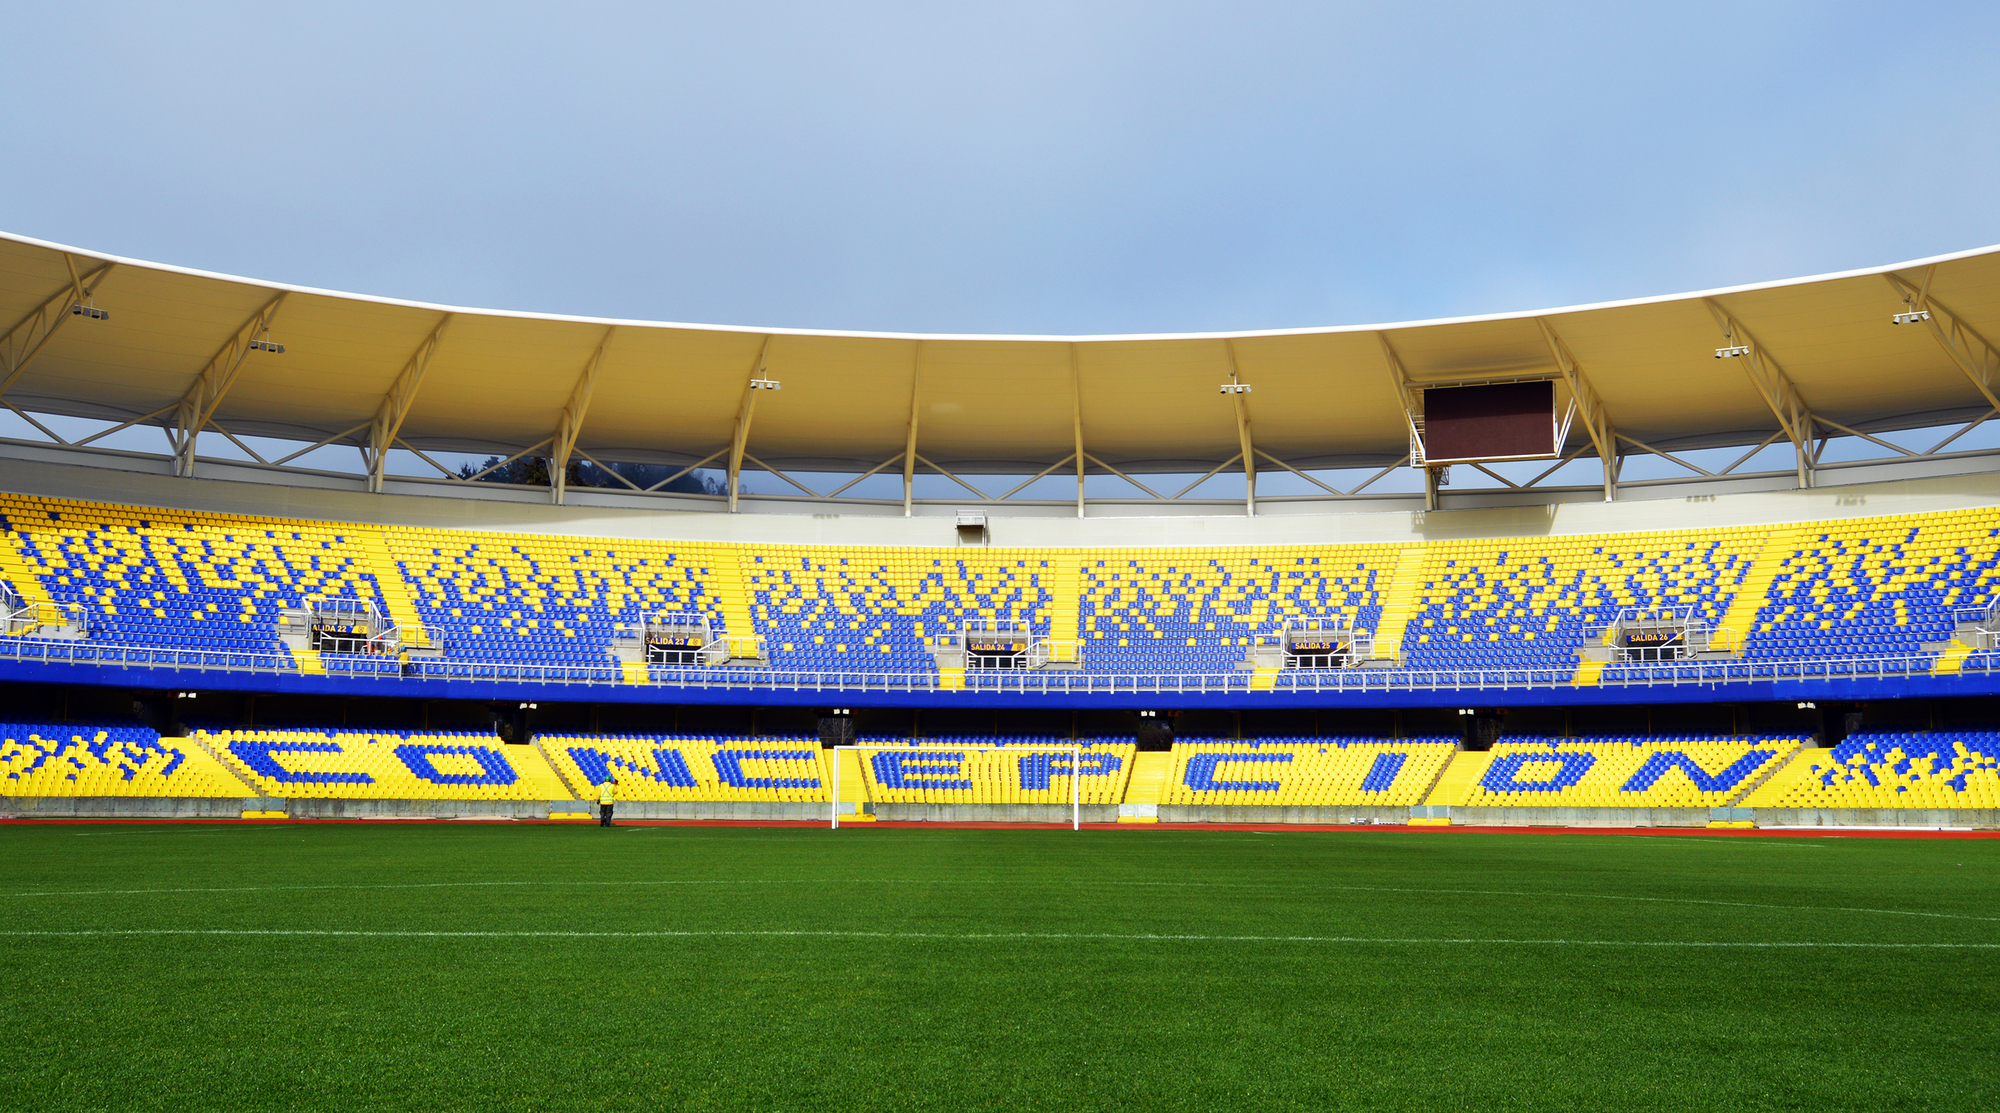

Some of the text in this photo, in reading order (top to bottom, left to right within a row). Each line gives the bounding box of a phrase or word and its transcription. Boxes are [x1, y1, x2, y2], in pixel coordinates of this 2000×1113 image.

[312, 624, 336, 632] ALIDA
[645, 637, 674, 645] SALIDA
[1630, 634, 1658, 642] SALIDA
[971, 643, 1006, 651] SALIDA 24
[1295, 642, 1321, 650] SALIDA
